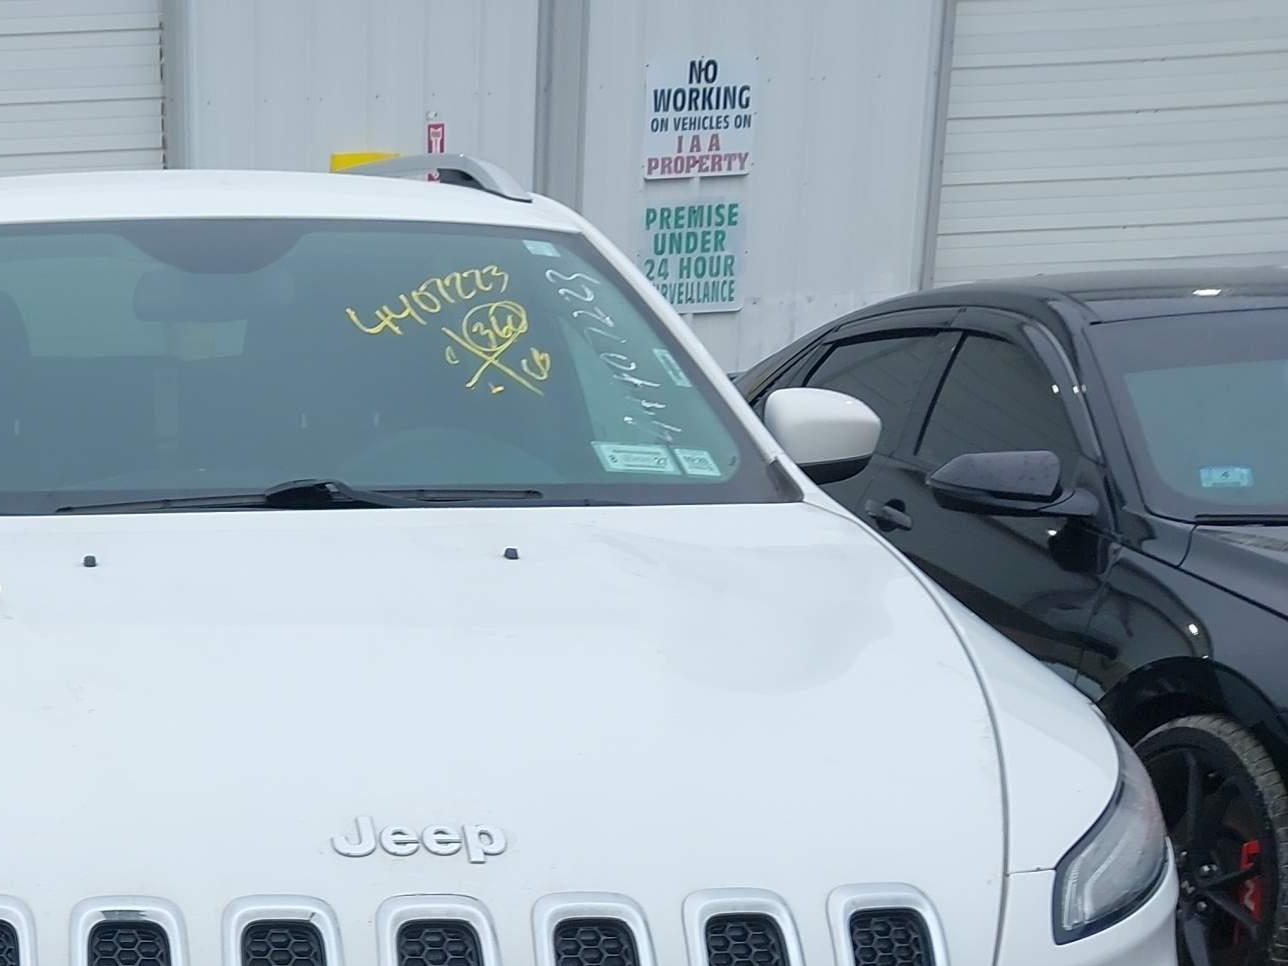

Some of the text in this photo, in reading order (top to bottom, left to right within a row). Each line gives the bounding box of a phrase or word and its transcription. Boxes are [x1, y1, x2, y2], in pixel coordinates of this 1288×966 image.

[688, 59, 718, 84] NO
[653, 85, 751, 113] WORKING
[650, 114, 752, 133] ON VEHICLES ON
[646, 153, 750, 175] PROPERTY
[645, 203, 739, 231] PREMISE
[653, 230, 726, 256] UNDER
[643, 255, 735, 281] 24 HOUR
[330, 816, 508, 864] Jeep
